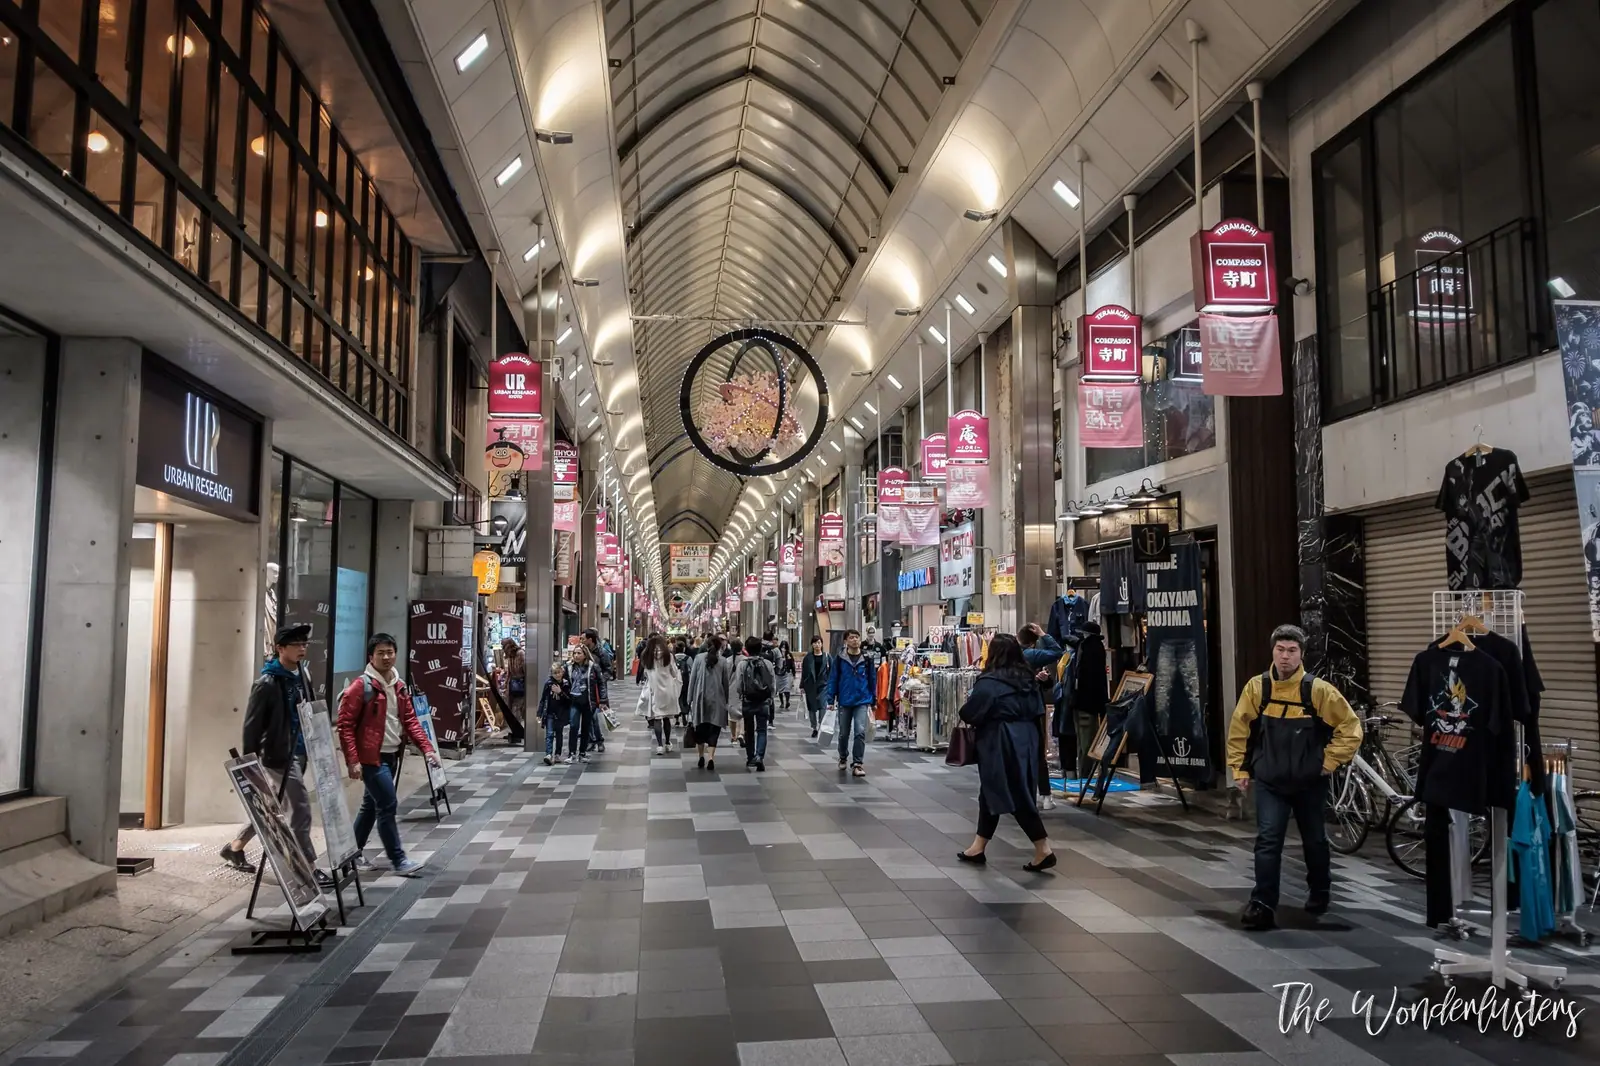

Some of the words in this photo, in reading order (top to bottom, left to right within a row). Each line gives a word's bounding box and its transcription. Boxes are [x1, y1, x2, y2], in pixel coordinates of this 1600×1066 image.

[1214, 222, 1259, 237] TERAMACHI
[1216, 258, 1262, 266] COMPASSO
[1222, 270, 1257, 289] 寺町
[1094, 308, 1130, 320] TERAMACHI
[500, 356, 532, 366] TERAMACHI
[1098, 347, 1127, 362] 寺町
[505, 373, 526, 390] UR
[186, 391, 221, 476] UR
[164, 464, 195, 491] URBAN
[195, 475, 233, 503] RESEARCH
[881, 487, 902, 497] パピヨ
[1146, 573, 1158, 589] IN
[1146, 589, 1198, 608] OKAYAMA
[412, 603, 426, 615] UR
[450, 605, 462, 616] UR
[1147, 609, 1192, 627] KOJIMA
[427, 623, 448, 640] UR
[428, 659, 441, 671] UR
[445, 677, 458, 688] UR
[444, 729, 458, 741] UR
